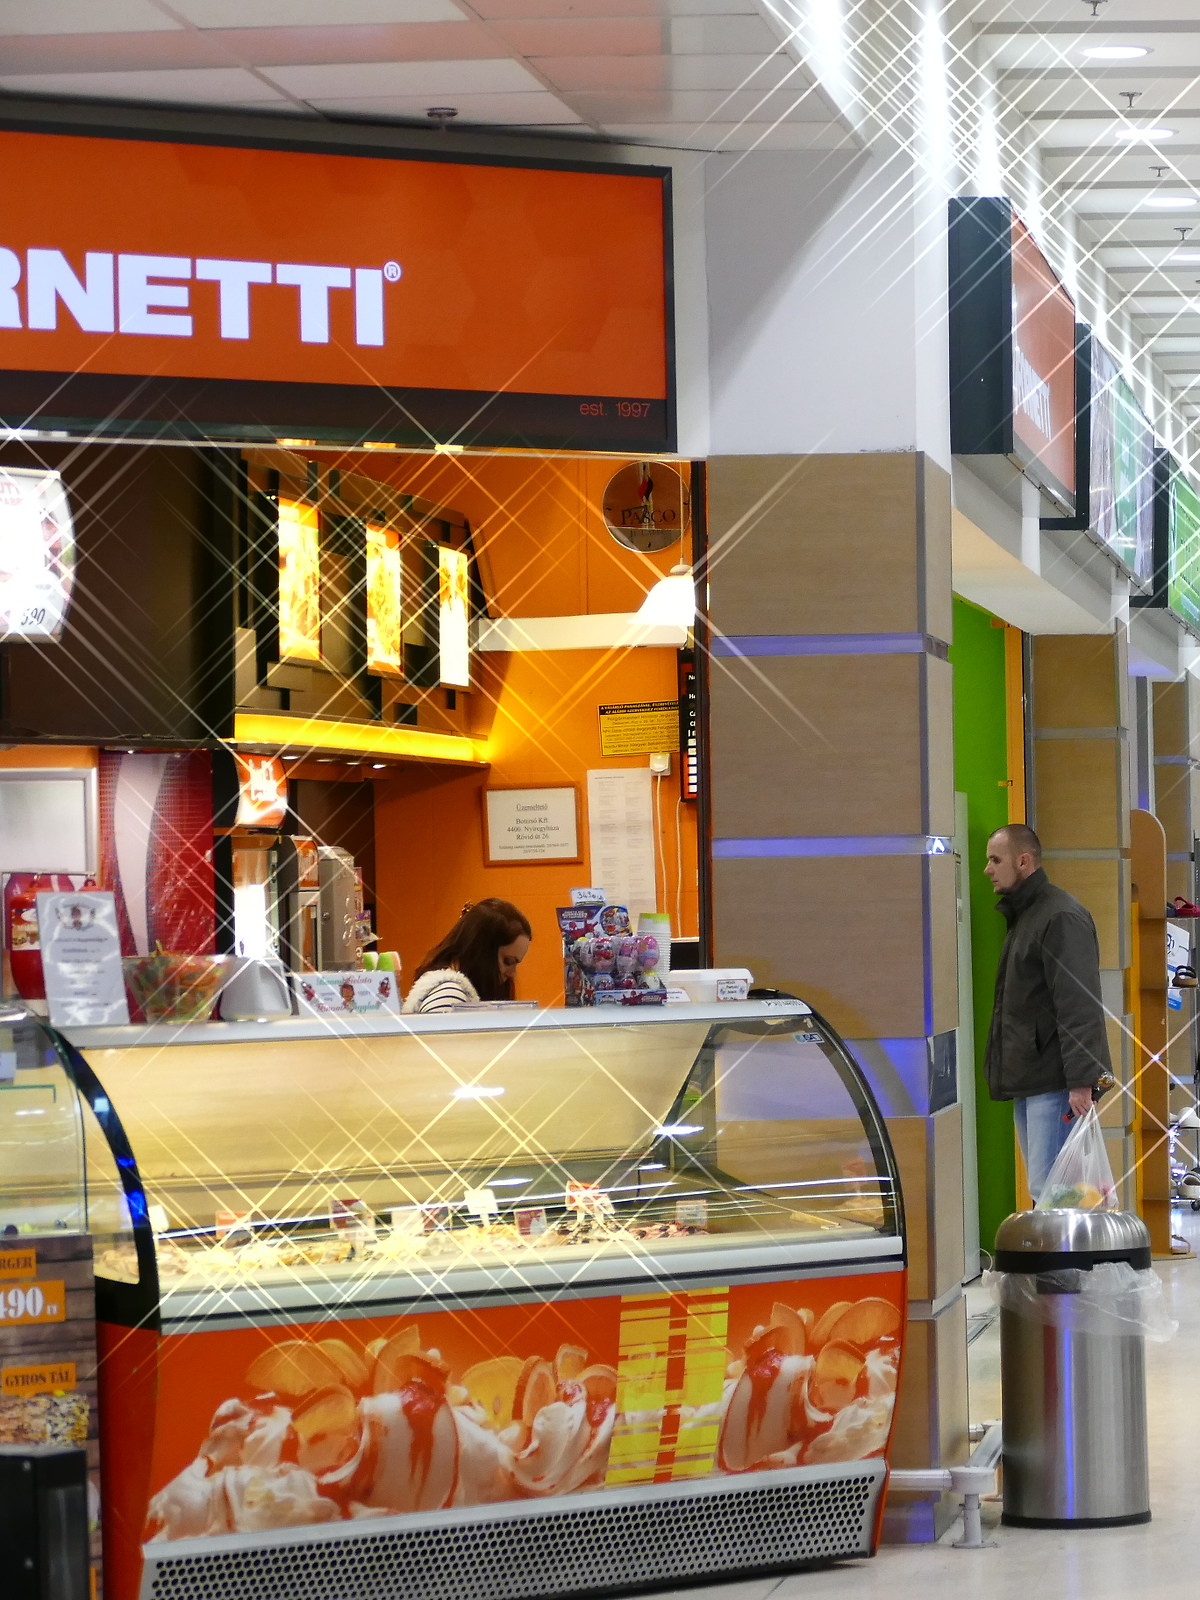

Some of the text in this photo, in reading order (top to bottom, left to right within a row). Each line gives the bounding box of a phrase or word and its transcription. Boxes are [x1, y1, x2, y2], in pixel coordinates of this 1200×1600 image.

[580, 401, 651, 418] est. 1997
[5, 1366, 71, 1388] GYROS TÁL
